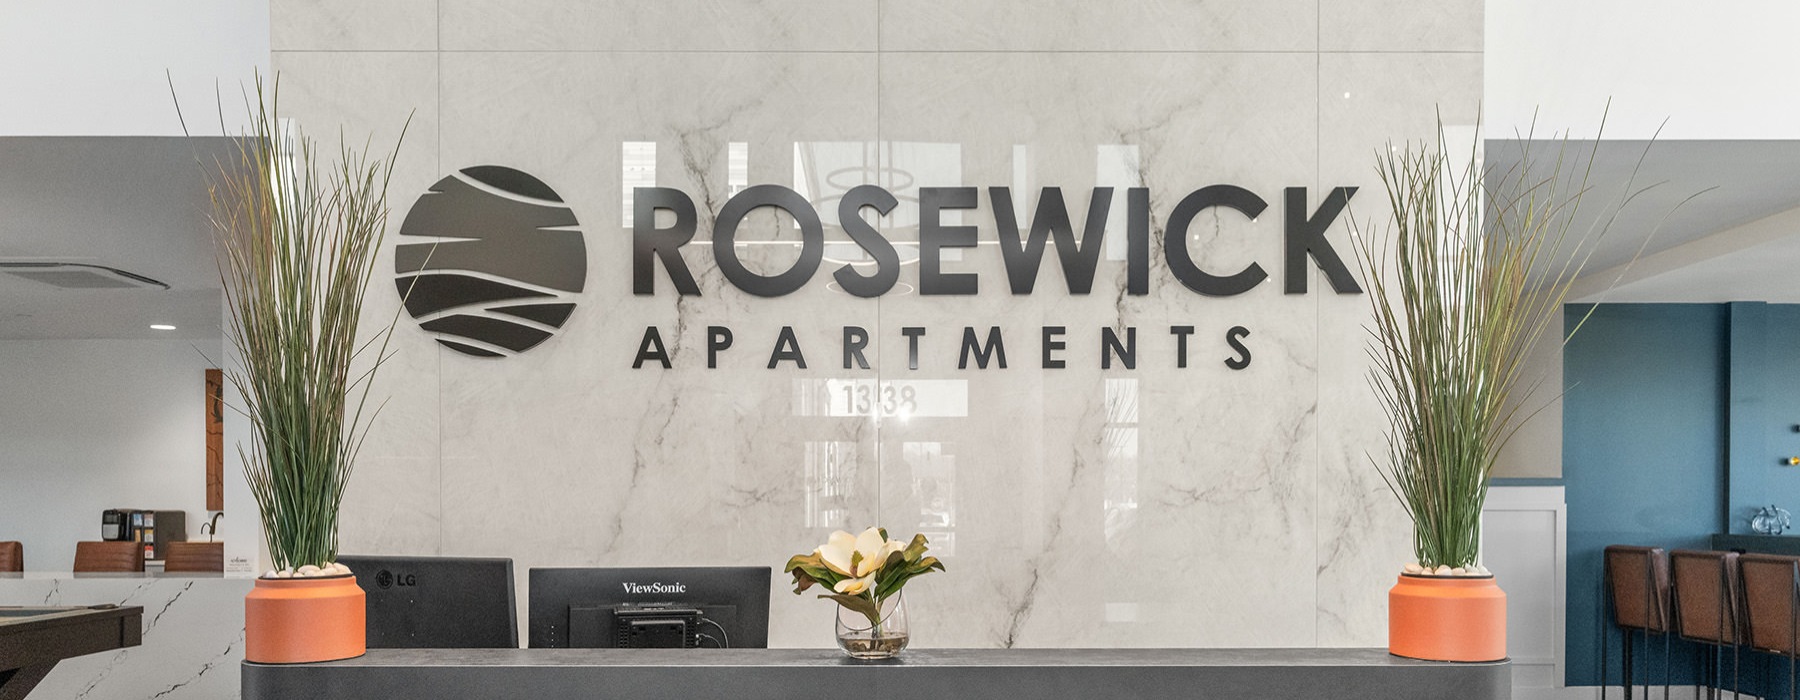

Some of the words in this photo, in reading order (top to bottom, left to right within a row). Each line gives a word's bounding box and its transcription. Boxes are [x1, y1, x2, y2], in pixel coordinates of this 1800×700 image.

[631, 184, 1364, 299] ROSEWICK
[631, 325, 1252, 370] APARTMENTS
[397, 574, 416, 587] LG
[622, 582, 686, 594] ViewSonic
